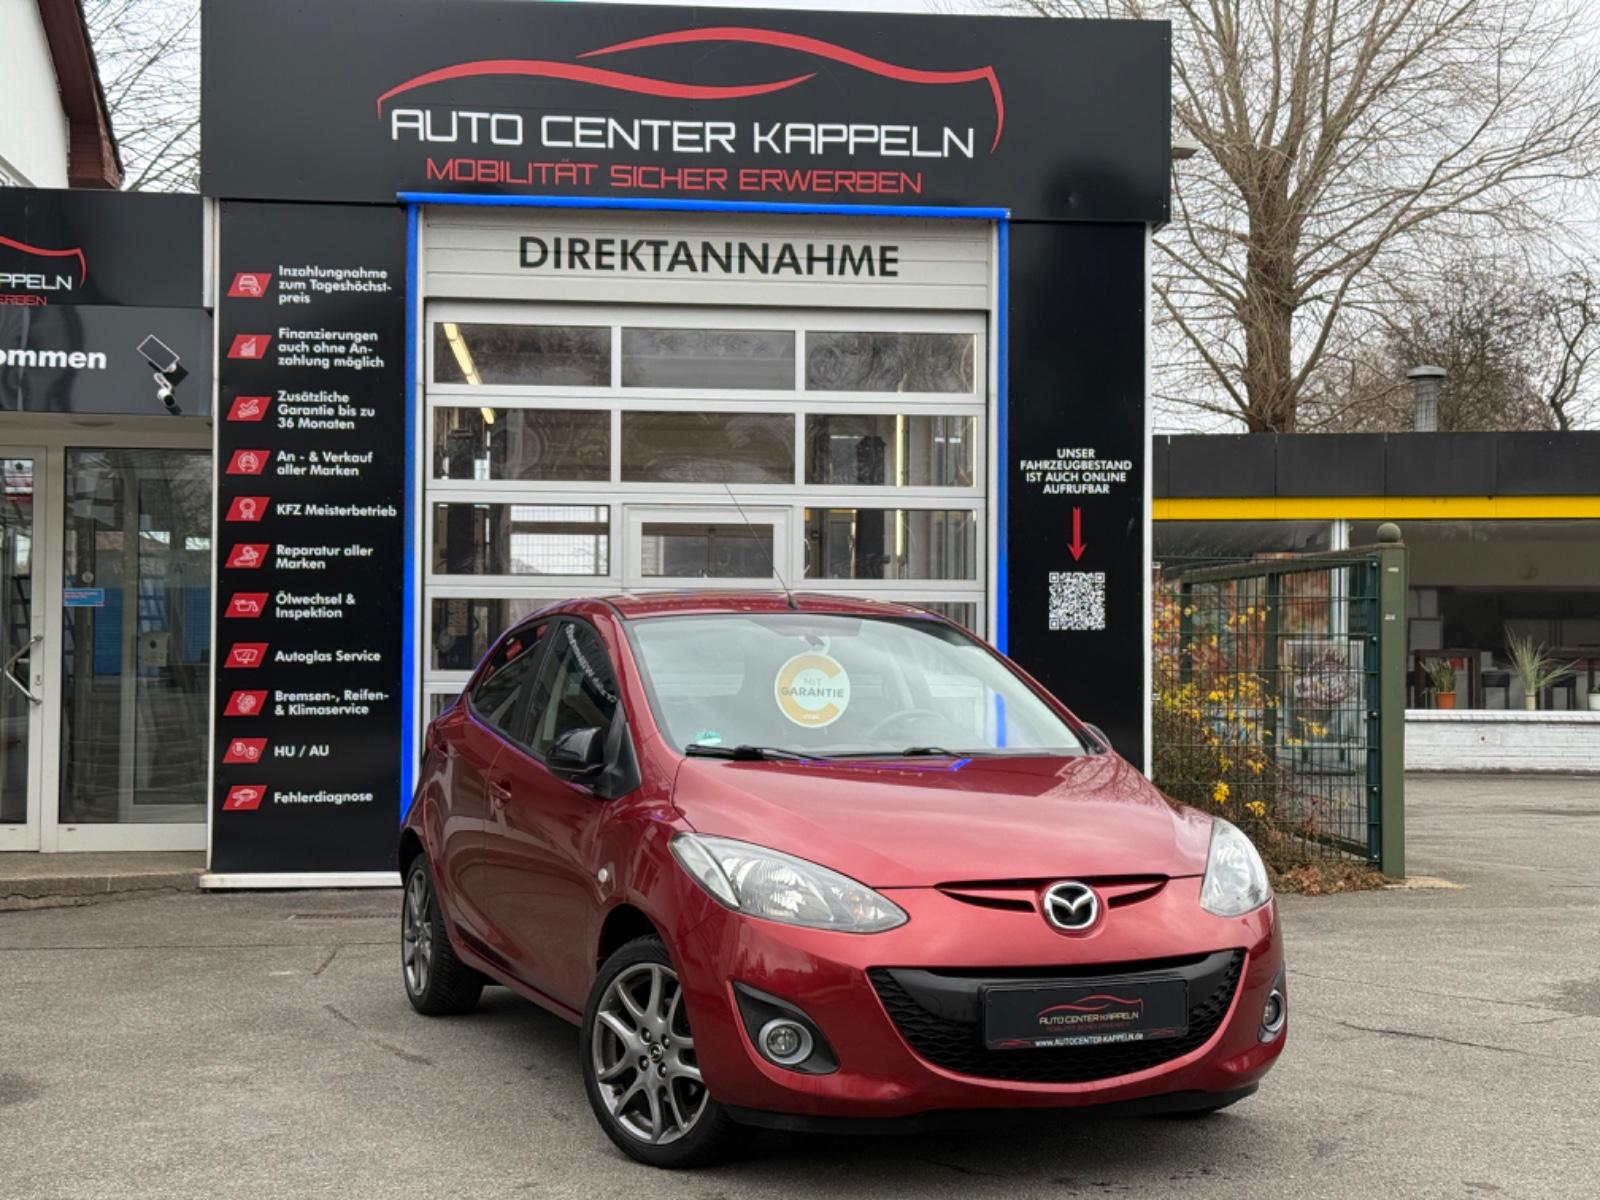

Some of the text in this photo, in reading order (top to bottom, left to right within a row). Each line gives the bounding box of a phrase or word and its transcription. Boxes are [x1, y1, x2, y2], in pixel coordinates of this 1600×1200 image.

[391, 108, 974, 159] AUTO CENTER KAPPELN
[426, 157, 923, 194] MOBILITÄT SICHER ERWERBEN
[519, 235, 899, 278] DIREKTANNAHME
[278, 265, 388, 281] Inzahlungnahme
[278, 279, 392, 294] zum Tageshöchst-
[278, 292, 311, 305] preis
[278, 327, 378, 343] Finanzierungen
[278, 341, 373, 355] auch ohne An-
[278, 354, 384, 370] zahlung möglich
[277, 390, 350, 403] Zusätzliche
[277, 404, 375, 418] Garantie bis zu
[277, 417, 355, 430] 36 Monaten
[277, 450, 296, 463] An
[309, 451, 319, 463] &
[322, 451, 373, 464] Verkauf
[1056, 448, 1096, 459] UNSER
[277, 465, 360, 477] aller Marken
[1020, 460, 1133, 471] FAHRZEUGBESTAND
[1026, 472, 1127, 483] IST AUCH ONLINE
[1043, 484, 1110, 495] AUFRUFBAR
[277, 504, 398, 518] KFZ Meisterbetrieb
[276, 544, 374, 558] Reparatur aller
[276, 558, 327, 570] Marken
[275, 590, 356, 606] Ölwechsel &
[276, 606, 343, 620] Inspektion
[274, 650, 382, 665] Autoglas Service
[275, 689, 390, 703] Bremsen-, Reifen-
[780, 686, 845, 698] GARANTIE
[275, 703, 370, 717] & Klimaservice
[274, 745, 330, 758] HU / AU
[274, 790, 374, 805] Fehlerdiagnose
[1039, 1016, 1064, 1025] AUTO
[1065, 1014, 1099, 1023] CENTER
